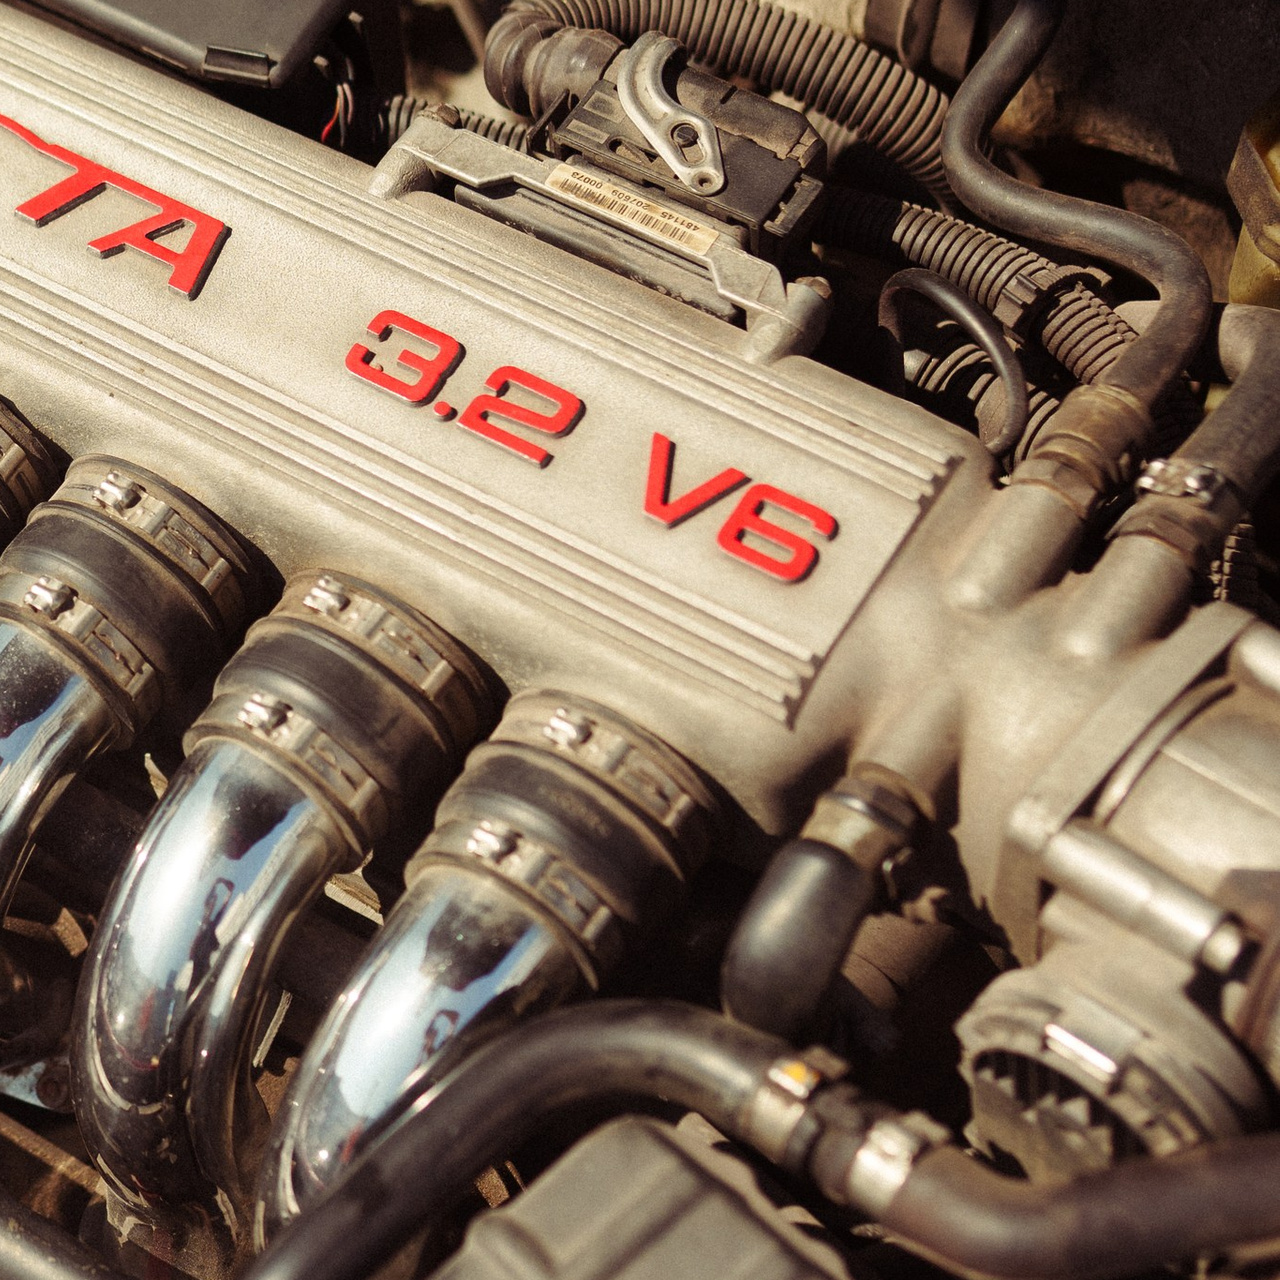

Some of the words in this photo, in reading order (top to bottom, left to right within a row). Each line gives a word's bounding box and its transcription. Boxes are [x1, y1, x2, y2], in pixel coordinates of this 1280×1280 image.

[570, 170, 604, 190] 00073
[661, 210, 701, 233] 481145
[345, 310, 582, 466] 3.2
[644, 432, 837, 582] V6
